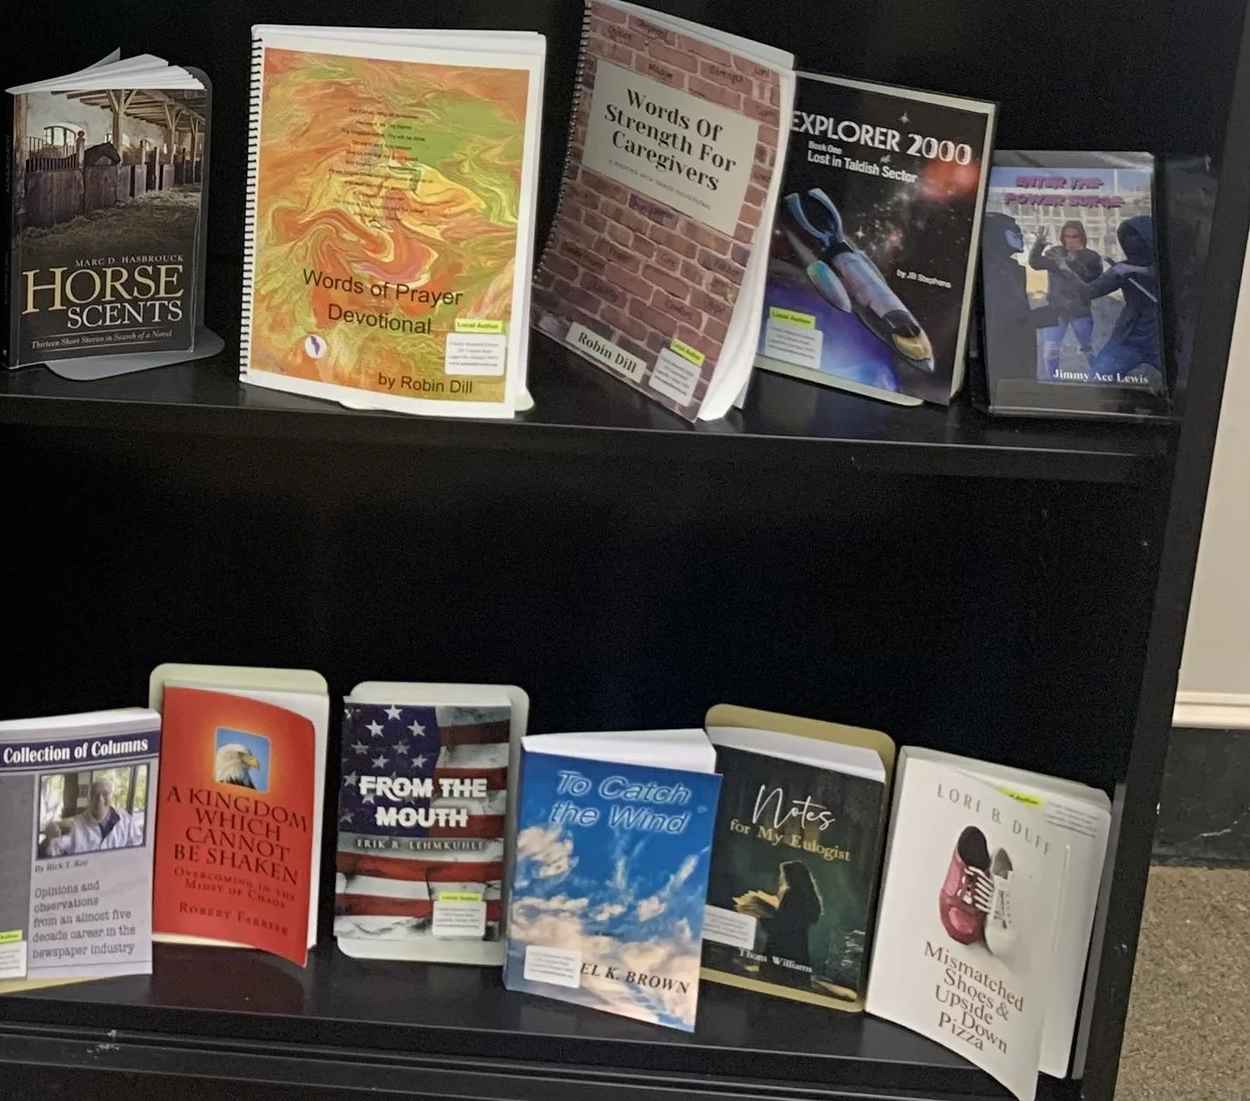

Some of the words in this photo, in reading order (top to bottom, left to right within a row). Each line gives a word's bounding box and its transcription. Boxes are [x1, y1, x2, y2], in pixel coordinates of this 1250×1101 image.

[627, 87, 690, 131] Words
[696, 118, 723, 142] Of
[605, 104, 692, 156] Strength
[700, 142, 736, 174] For
[791, 110, 900, 152] EXPLORER
[907, 133, 972, 166] 2000
[808, 141, 825, 151] Book
[826, 144, 842, 155] One
[612, 130, 719, 191] Caregivers
[807, 151, 830, 165] Lost
[832, 155, 842, 167] in
[844, 157, 879, 176] Taldish
[881, 165, 917, 184] Sector
[75, 257, 106, 268] MARC
[121, 254, 184, 264] HASBROUCK
[21, 264, 185, 316] HORSE
[303, 267, 364, 295] Words
[370, 281, 393, 299] of
[396, 284, 463, 311] Prayer
[896, 270, 906, 281] by
[918, 272, 951, 288] Stephens
[67, 300, 183, 330] SCENTS
[327, 304, 431, 335] Devotional
[31, 339, 59, 350] Thirteen
[61, 336, 80, 347] Short
[81, 334, 104, 345] Stories
[106, 334, 112, 342] in
[113, 331, 137, 342] Search
[137, 330, 146, 341] of
[152, 329, 173, 339] Novel
[576, 331, 611, 360] Robin
[614, 348, 637, 374] Dill
[378, 372, 396, 389] by
[400, 375, 445, 393] Robin
[449, 380, 473, 394] Dill
[1053, 367, 1089, 384] Jimmy
[1092, 370, 1113, 382] Ace
[1117, 372, 1149, 385] Lewis
[3, 745, 71, 765] Collection
[74, 741, 88, 758] of
[91, 737, 149, 757] Columns
[359, 775, 433, 801] FROM
[439, 778, 487, 798] THE
[556, 770, 592, 797] To
[598, 775, 692, 804] Catch
[166, 786, 181, 804] A
[188, 788, 307, 833] KINGDOM
[375, 807, 469, 828] MOUTH
[549, 799, 599, 826] the
[609, 805, 691, 834] Wind
[752, 784, 835, 831] Notes
[938, 783, 981, 812] LORI
[1012, 819, 1051, 856] DUFF
[195, 808, 281, 842] WHICH
[730, 819, 751, 834] for
[758, 825, 783, 846] My
[790, 832, 850, 861] Eulogist
[185, 826, 290, 862] CANNOT
[357, 839, 385, 849] ERIK
[174, 843, 200, 863] BE
[206, 848, 298, 886] SHAKEN
[34, 884, 79, 899] Opinions
[81, 880, 100, 892] and
[34, 897, 99, 914] observations
[32, 930, 68, 943] decade
[70, 928, 104, 939] career
[106, 926, 116, 937] in
[118, 925, 136, 936] the
[33, 916, 58, 928] from
[60, 916, 73, 925] an
[75, 911, 110, 923] almost
[112, 909, 131, 920] five
[32, 945, 88, 959] newspaper
[90, 943, 135, 955] industry
[772, 956, 813, 973] Williams
[605, 966, 619, 981] K.
[625, 970, 690, 994] BROWN
[924, 941, 1024, 1012] Mismatched
[935, 985, 994, 1025] Upside
[943, 968, 994, 1008] Shoes
[995, 1002, 1010, 1021] &
[938, 1012, 984, 1051] Pizza
[961, 1012, 1007, 1054] Down
